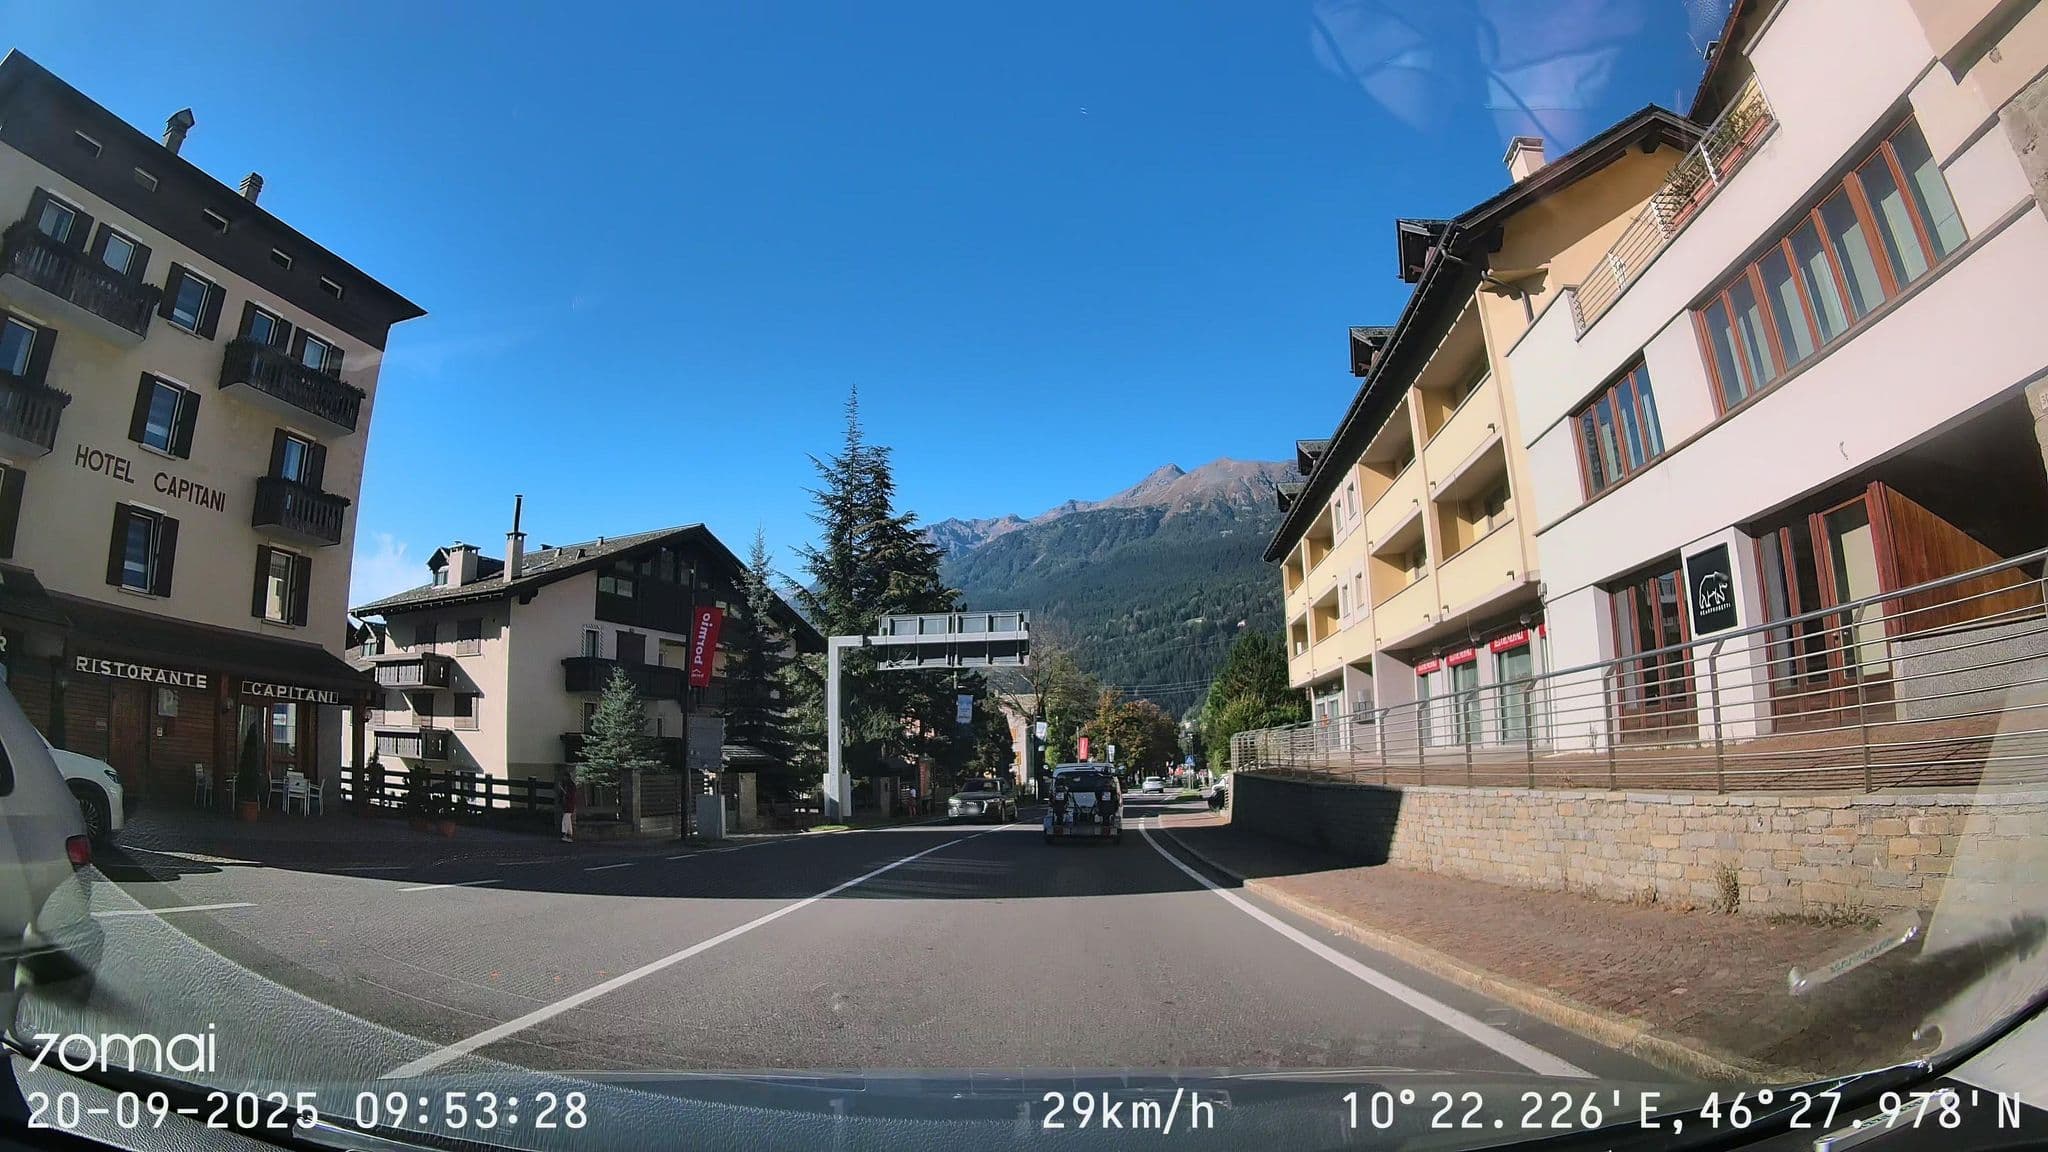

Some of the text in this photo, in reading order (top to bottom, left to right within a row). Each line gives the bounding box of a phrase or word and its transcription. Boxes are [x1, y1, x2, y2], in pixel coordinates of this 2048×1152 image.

[75, 444, 226, 513] HOTEL CAPITANI
[76, 655, 208, 689] RISTORANTE
[250, 682, 336, 704] CAPITANI
